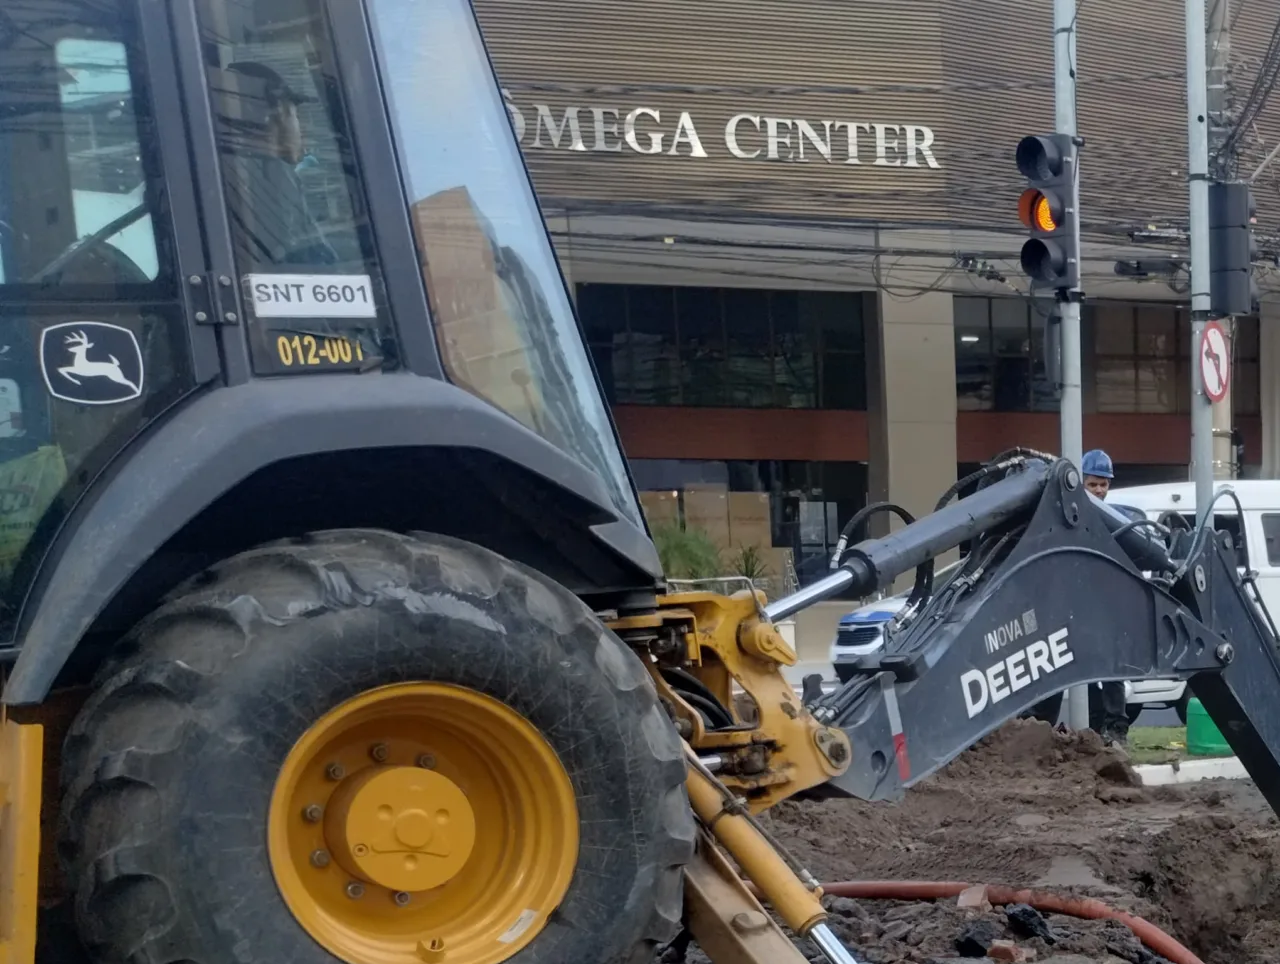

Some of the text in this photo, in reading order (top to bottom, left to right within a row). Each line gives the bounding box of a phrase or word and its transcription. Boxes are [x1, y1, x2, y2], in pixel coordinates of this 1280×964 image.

[724, 113, 942, 169] CENTER
[255, 283, 368, 303] SNT 6601
[984, 619, 1023, 655] INOVA
[960, 627, 1074, 719] DEERE
